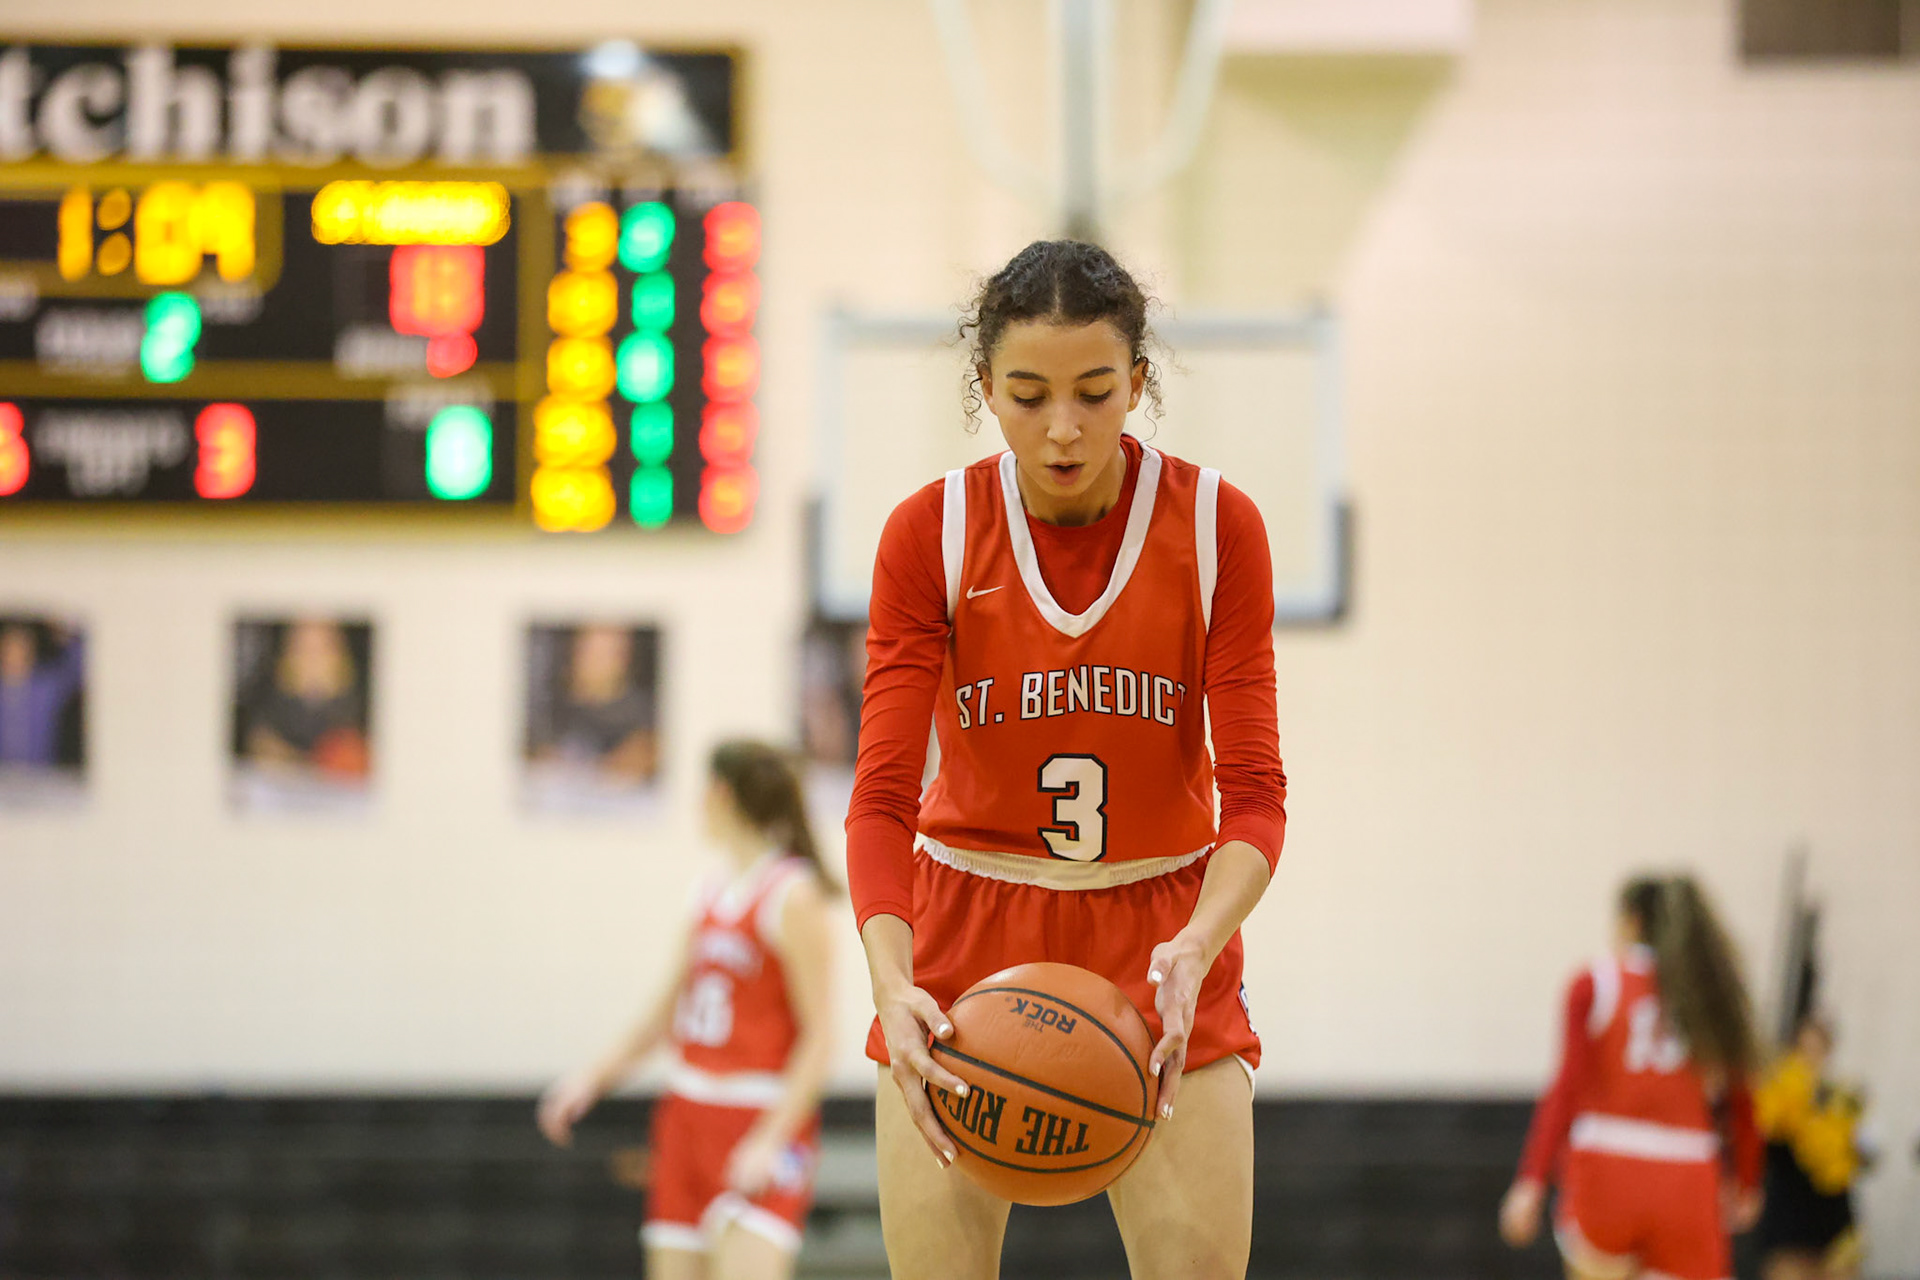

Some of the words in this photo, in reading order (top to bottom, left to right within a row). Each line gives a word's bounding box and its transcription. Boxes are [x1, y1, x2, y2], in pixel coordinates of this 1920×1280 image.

[956, 677, 1005, 729] ST.
[1037, 753, 1108, 862] 3
[1009, 997, 1077, 1034] ROCK
[1024, 1018, 1045, 1033] THE
[1015, 1105, 1090, 1156] THE
